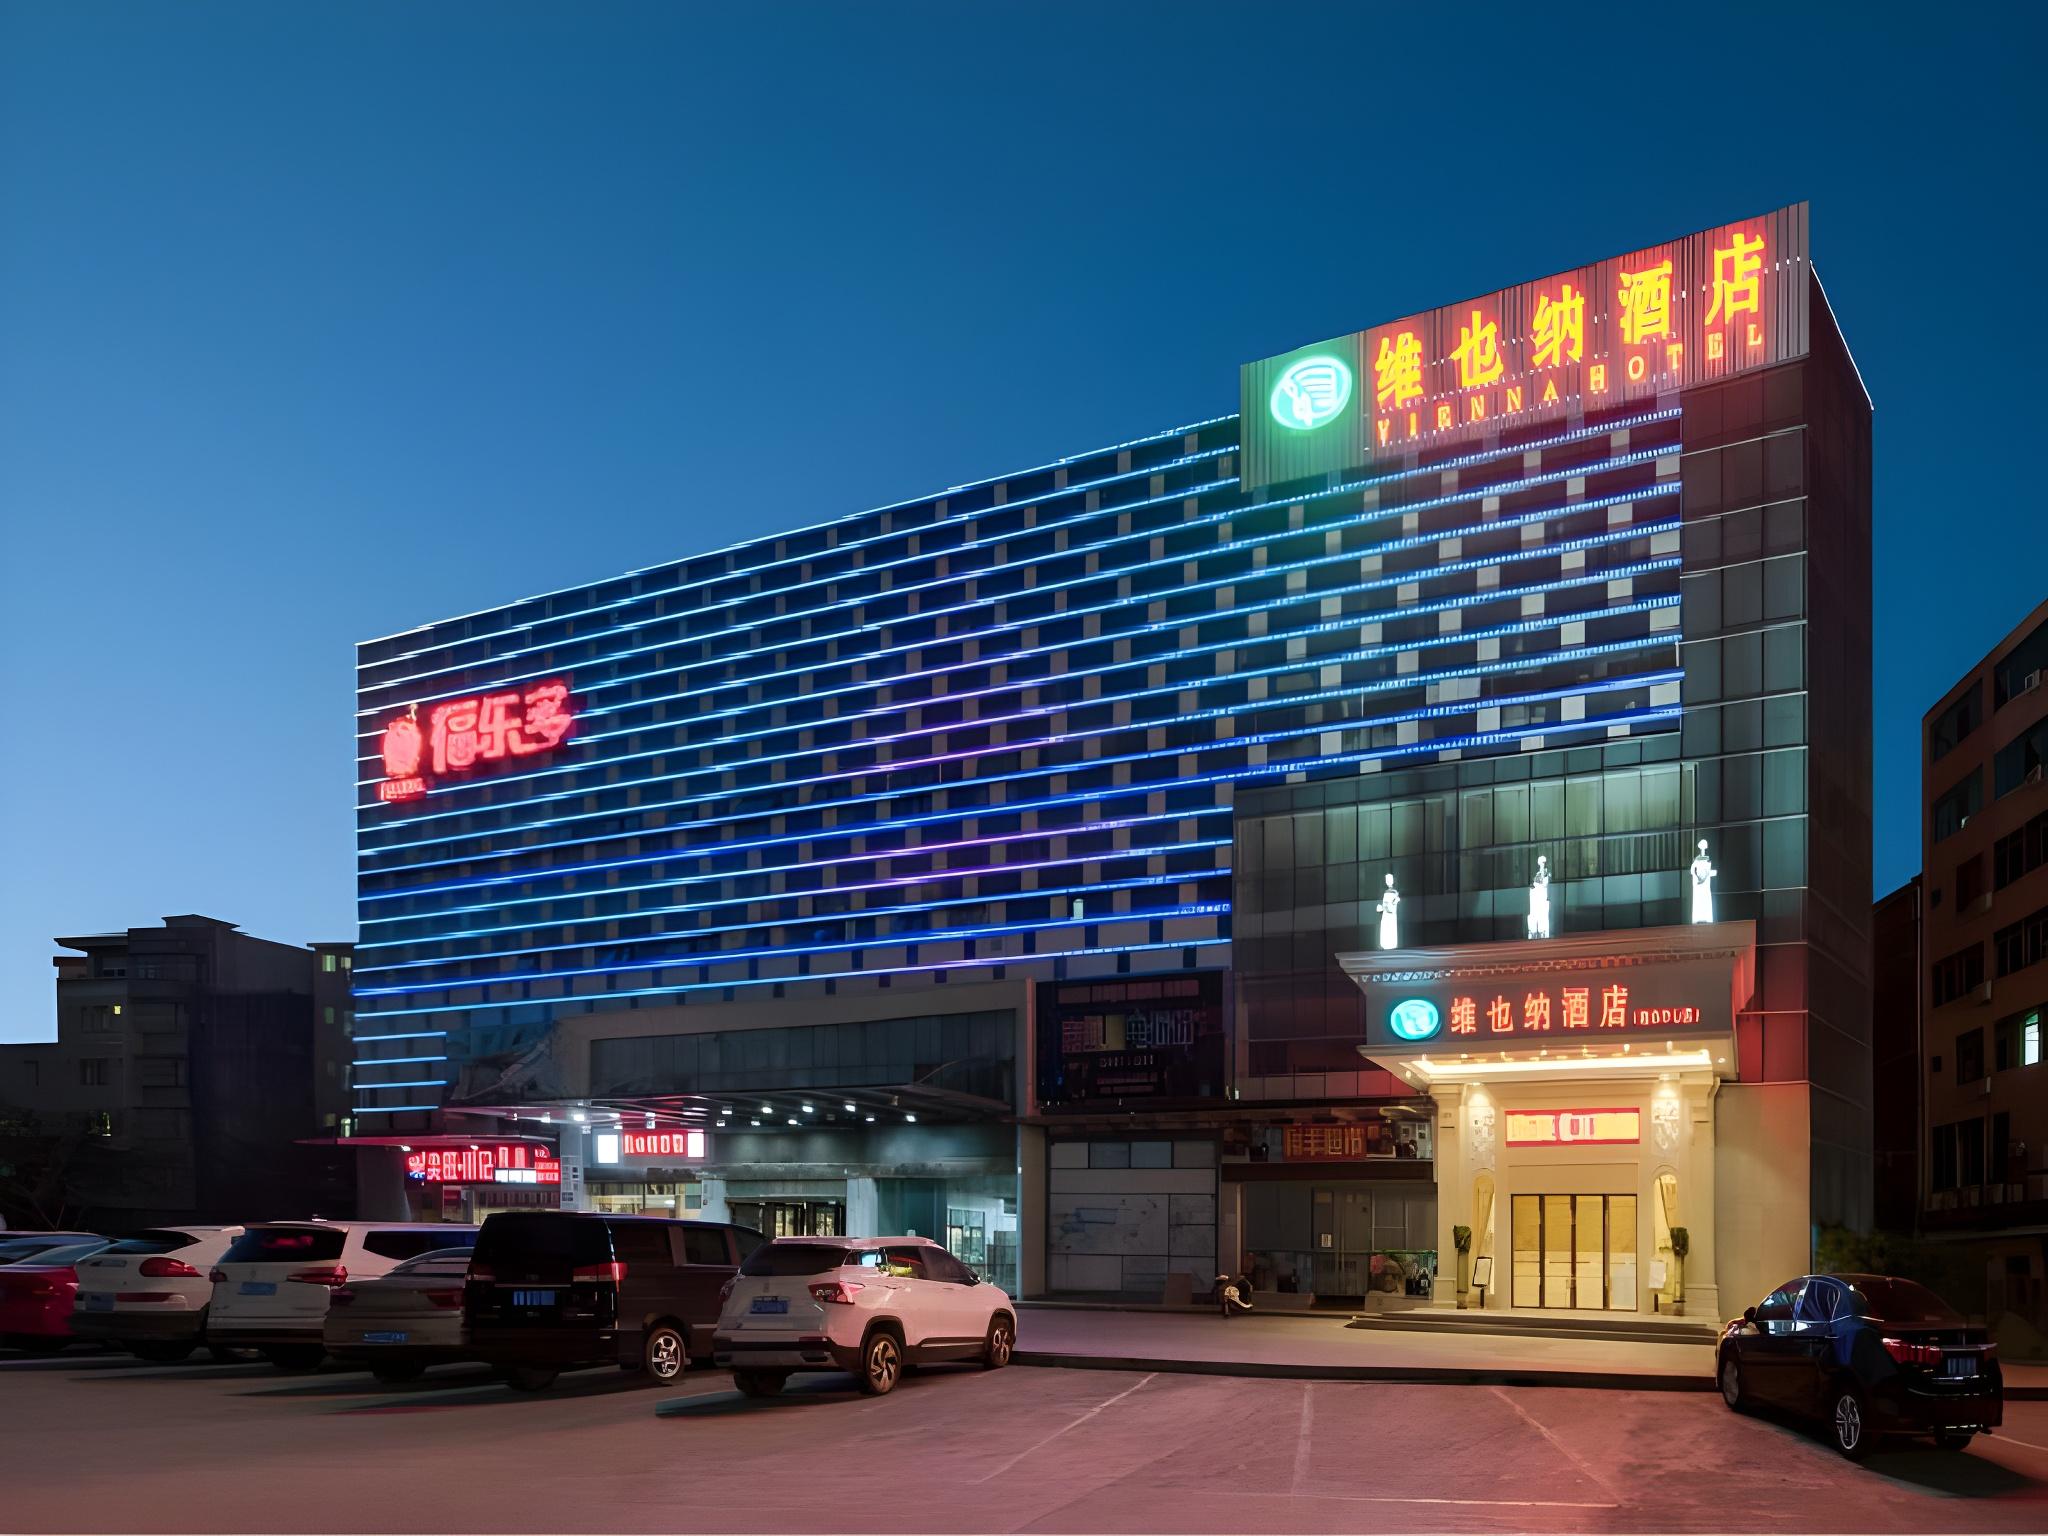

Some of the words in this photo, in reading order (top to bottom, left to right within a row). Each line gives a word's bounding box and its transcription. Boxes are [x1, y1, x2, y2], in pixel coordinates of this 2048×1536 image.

[1375, 233, 1765, 408] 维也纳酒店
[1589, 323, 1762, 392] HOTEL
[1451, 984, 1629, 1034] 维也纳酒店
